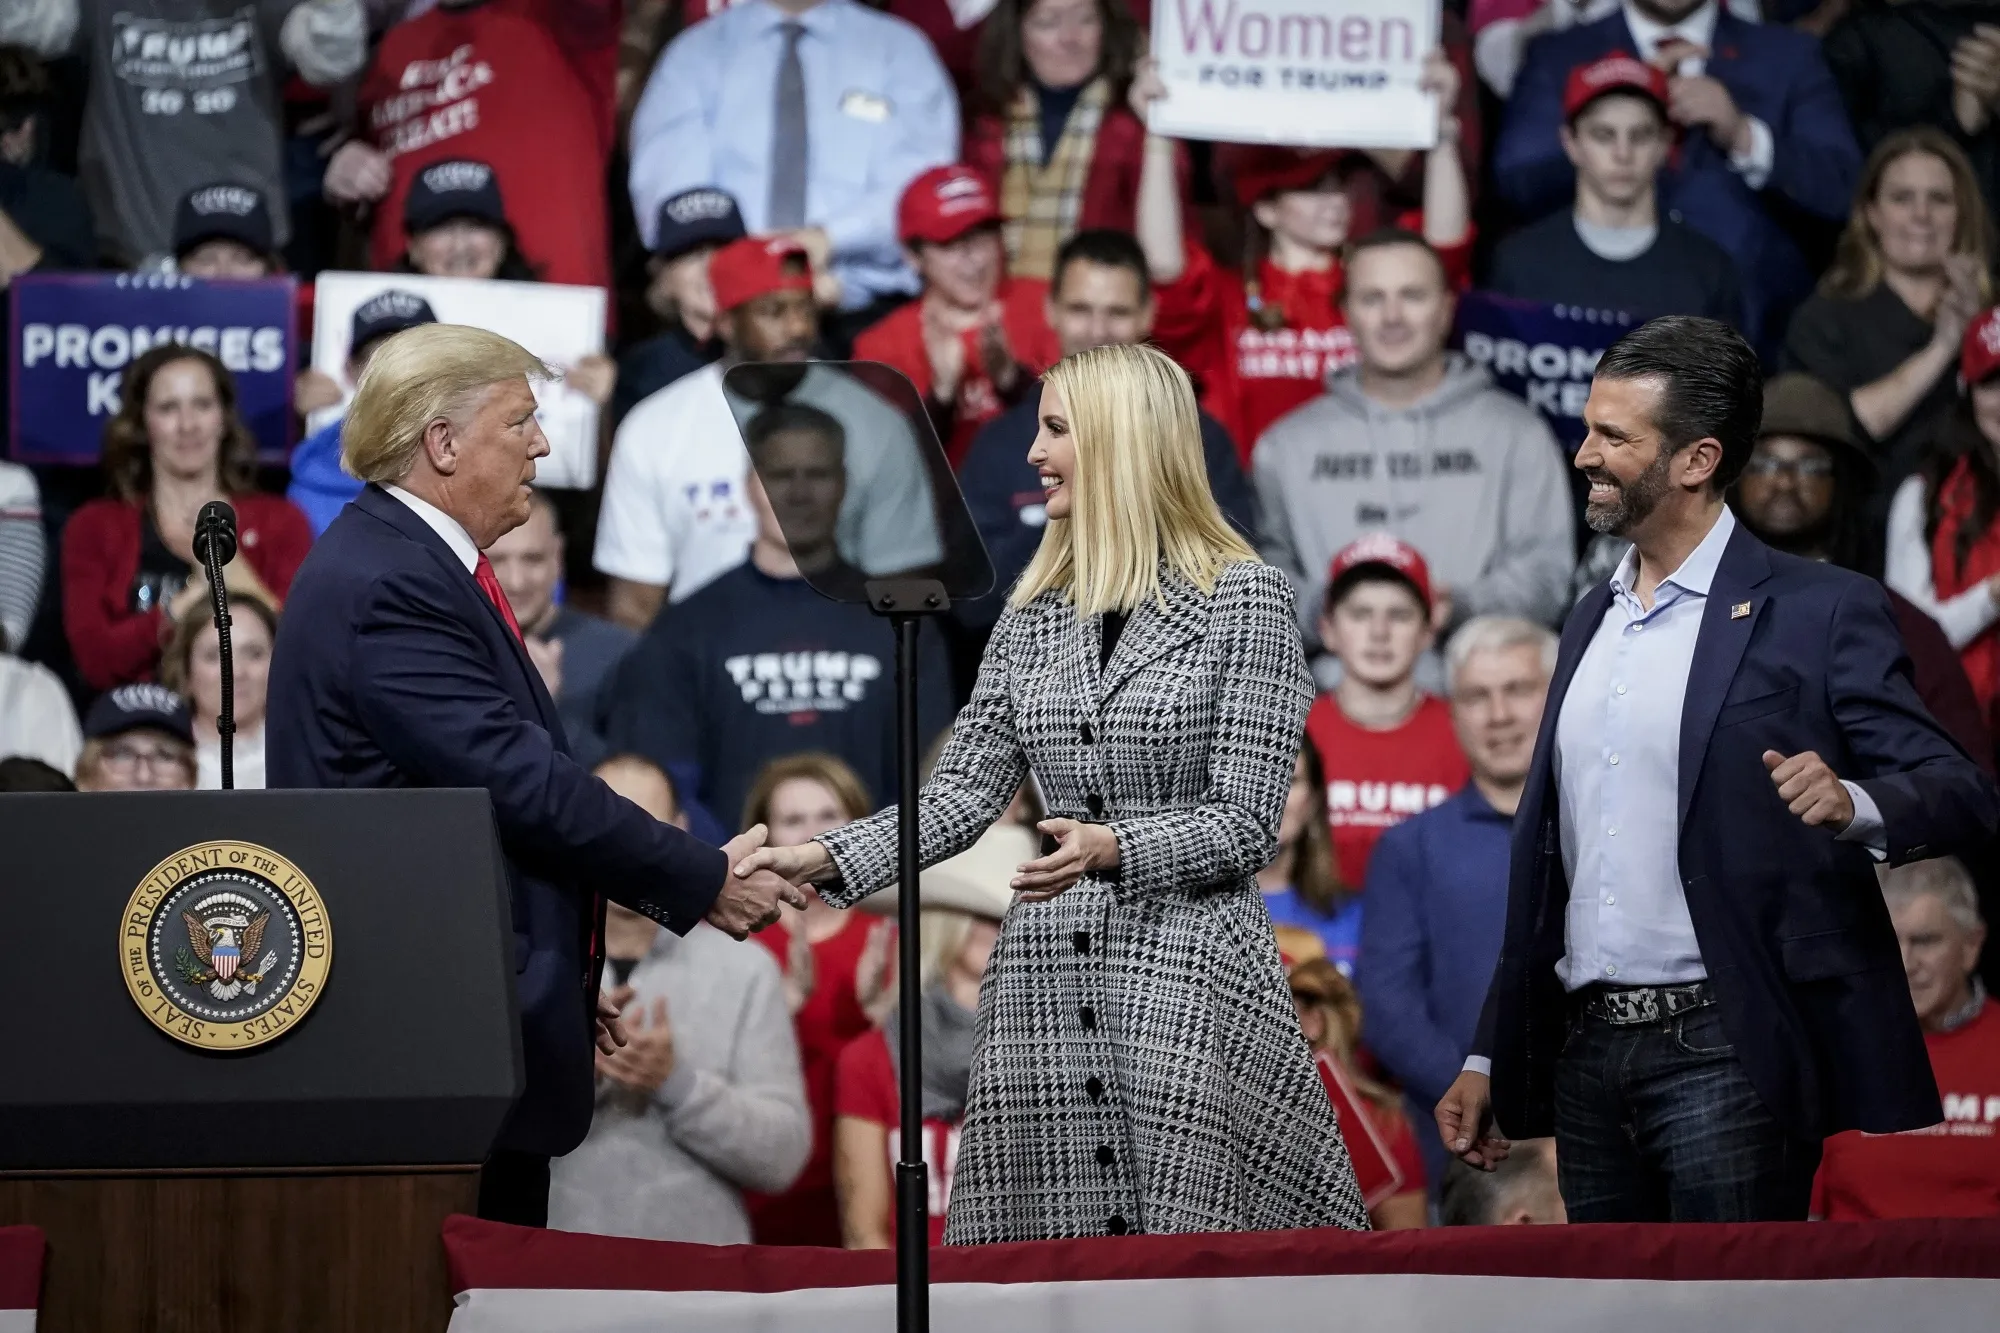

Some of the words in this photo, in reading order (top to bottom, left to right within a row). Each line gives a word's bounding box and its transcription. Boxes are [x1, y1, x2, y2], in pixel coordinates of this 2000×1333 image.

[1176, 0, 1415, 62] Women
[1199, 64, 1263, 88] FOR
[1280, 66, 1388, 91] TRUMP
[1464, 331, 1606, 381] PROM
[1526, 377, 1592, 419] KE
[725, 651, 881, 686] TRUMP
[1327, 779, 1447, 814] RUMP
[229, 850, 249, 864] OF
[253, 855, 279, 876] THE
[128, 848, 223, 939] PRESIDENT
[283, 873, 325, 960] UNITED
[129, 946, 145, 976] THE
[136, 979, 153, 998] OF
[152, 994, 205, 1041] SEAL
[243, 977, 315, 1041] STATES
